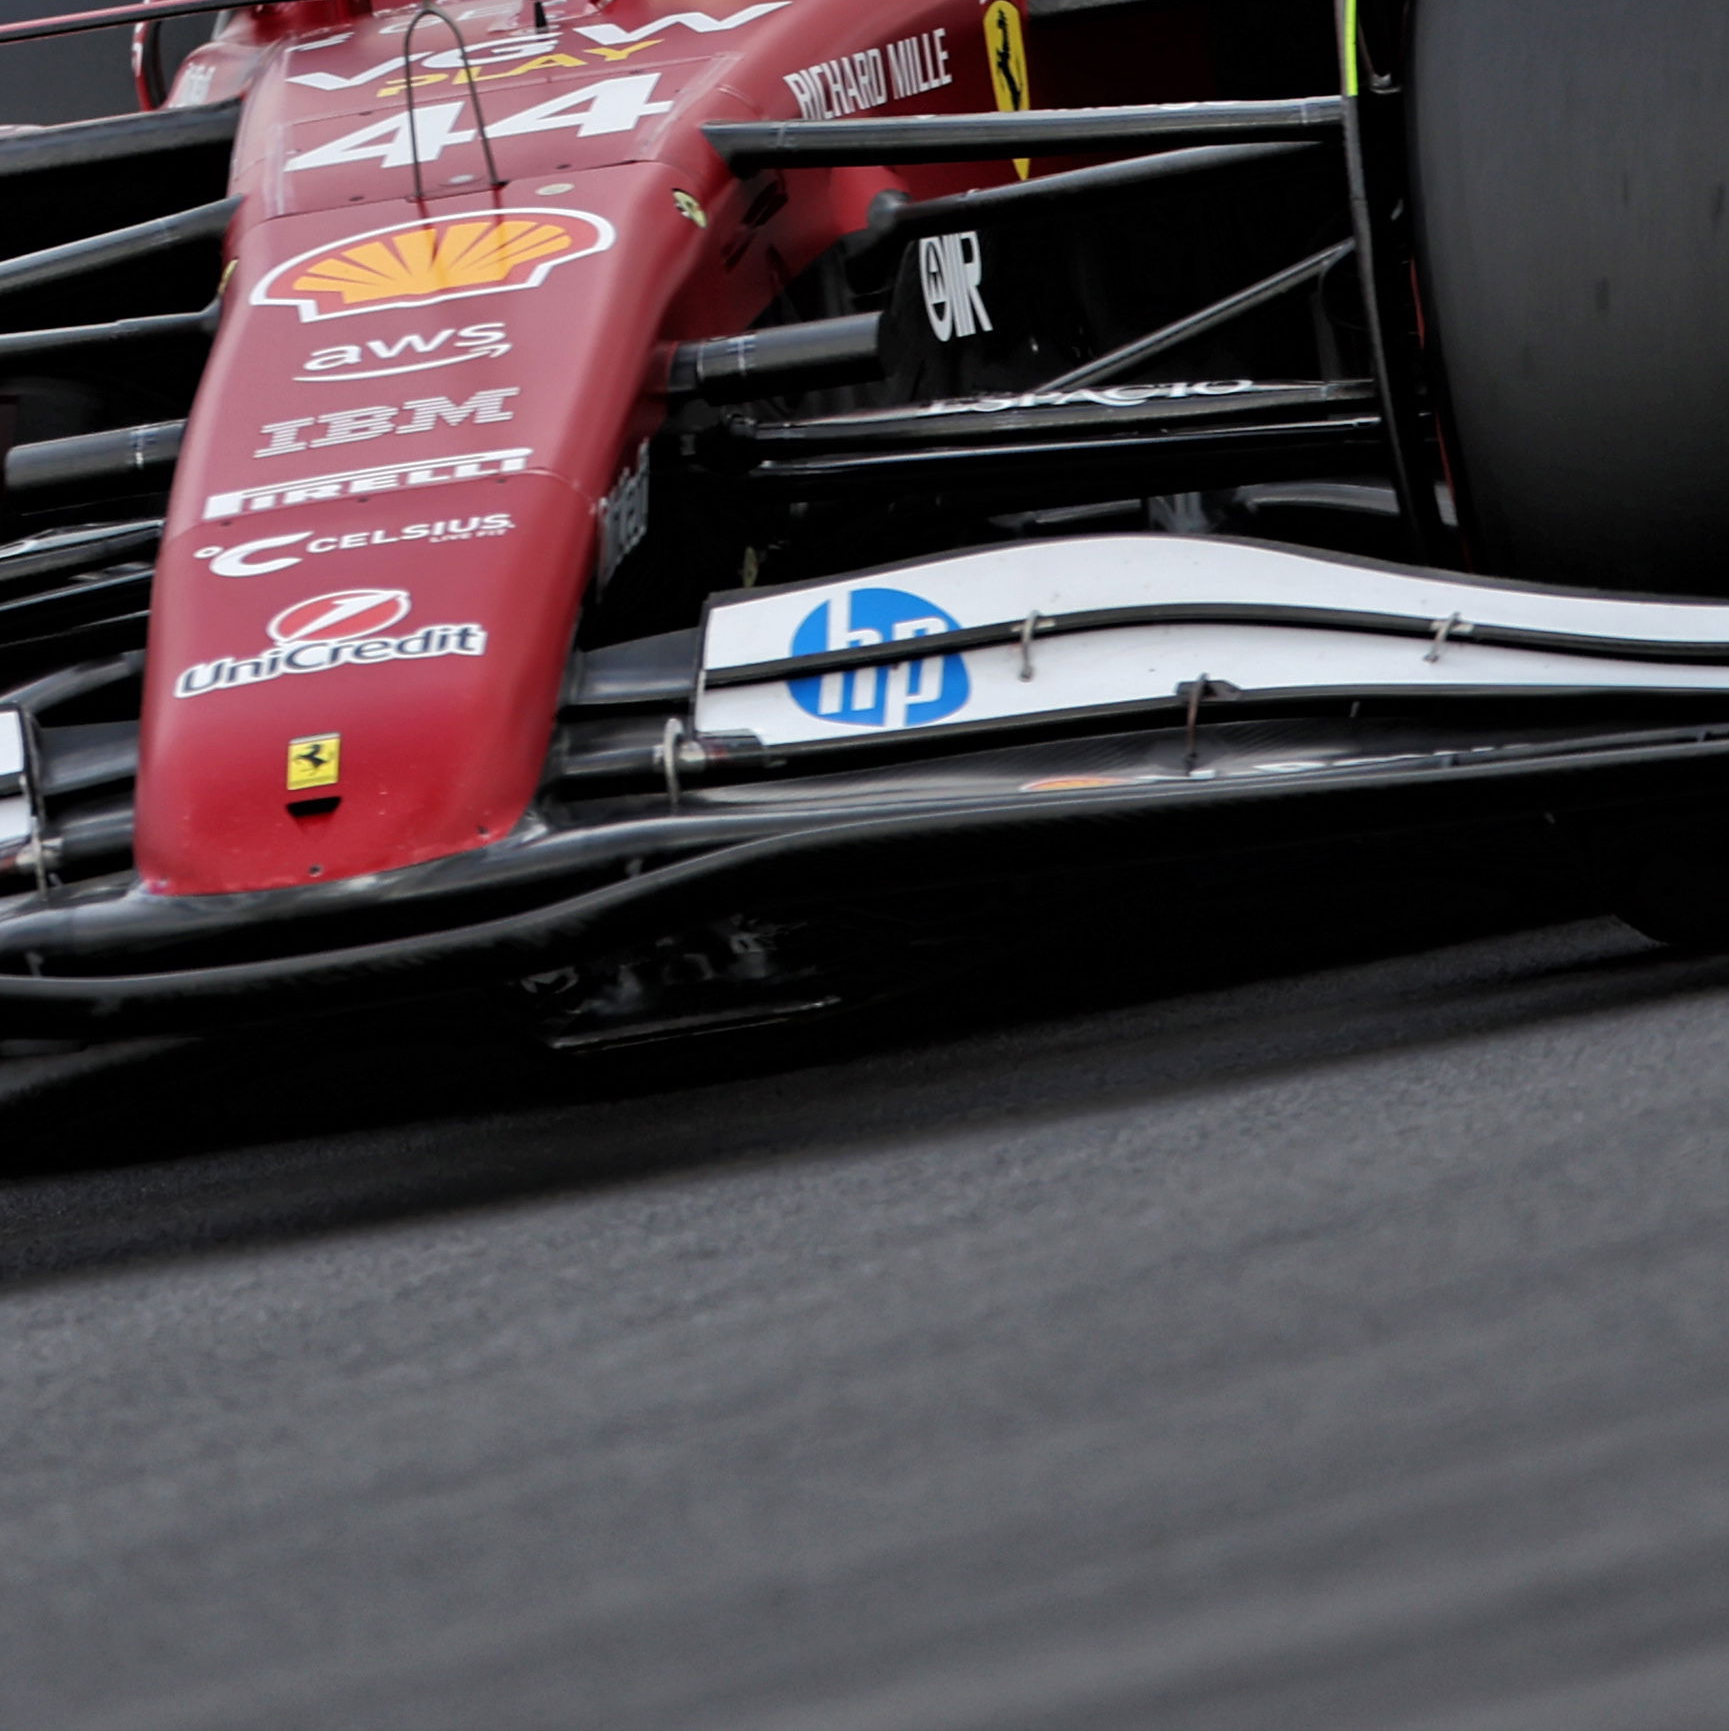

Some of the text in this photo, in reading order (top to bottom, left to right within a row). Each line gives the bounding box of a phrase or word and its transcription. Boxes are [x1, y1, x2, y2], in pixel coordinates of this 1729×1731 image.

[286, 1, 794, 91] VGW
[377, 39, 665, 97] PLAY
[782, 27, 953, 121] RICHARD MILLE
[284, 73, 674, 171] 44
[302, 321, 508, 371] aws
[253, 386, 521, 459] IBM
[202, 447, 534, 520] PIRELLI
[306, 513, 516, 553] CELSIUS
[181, 625, 483, 697] UniCredit
